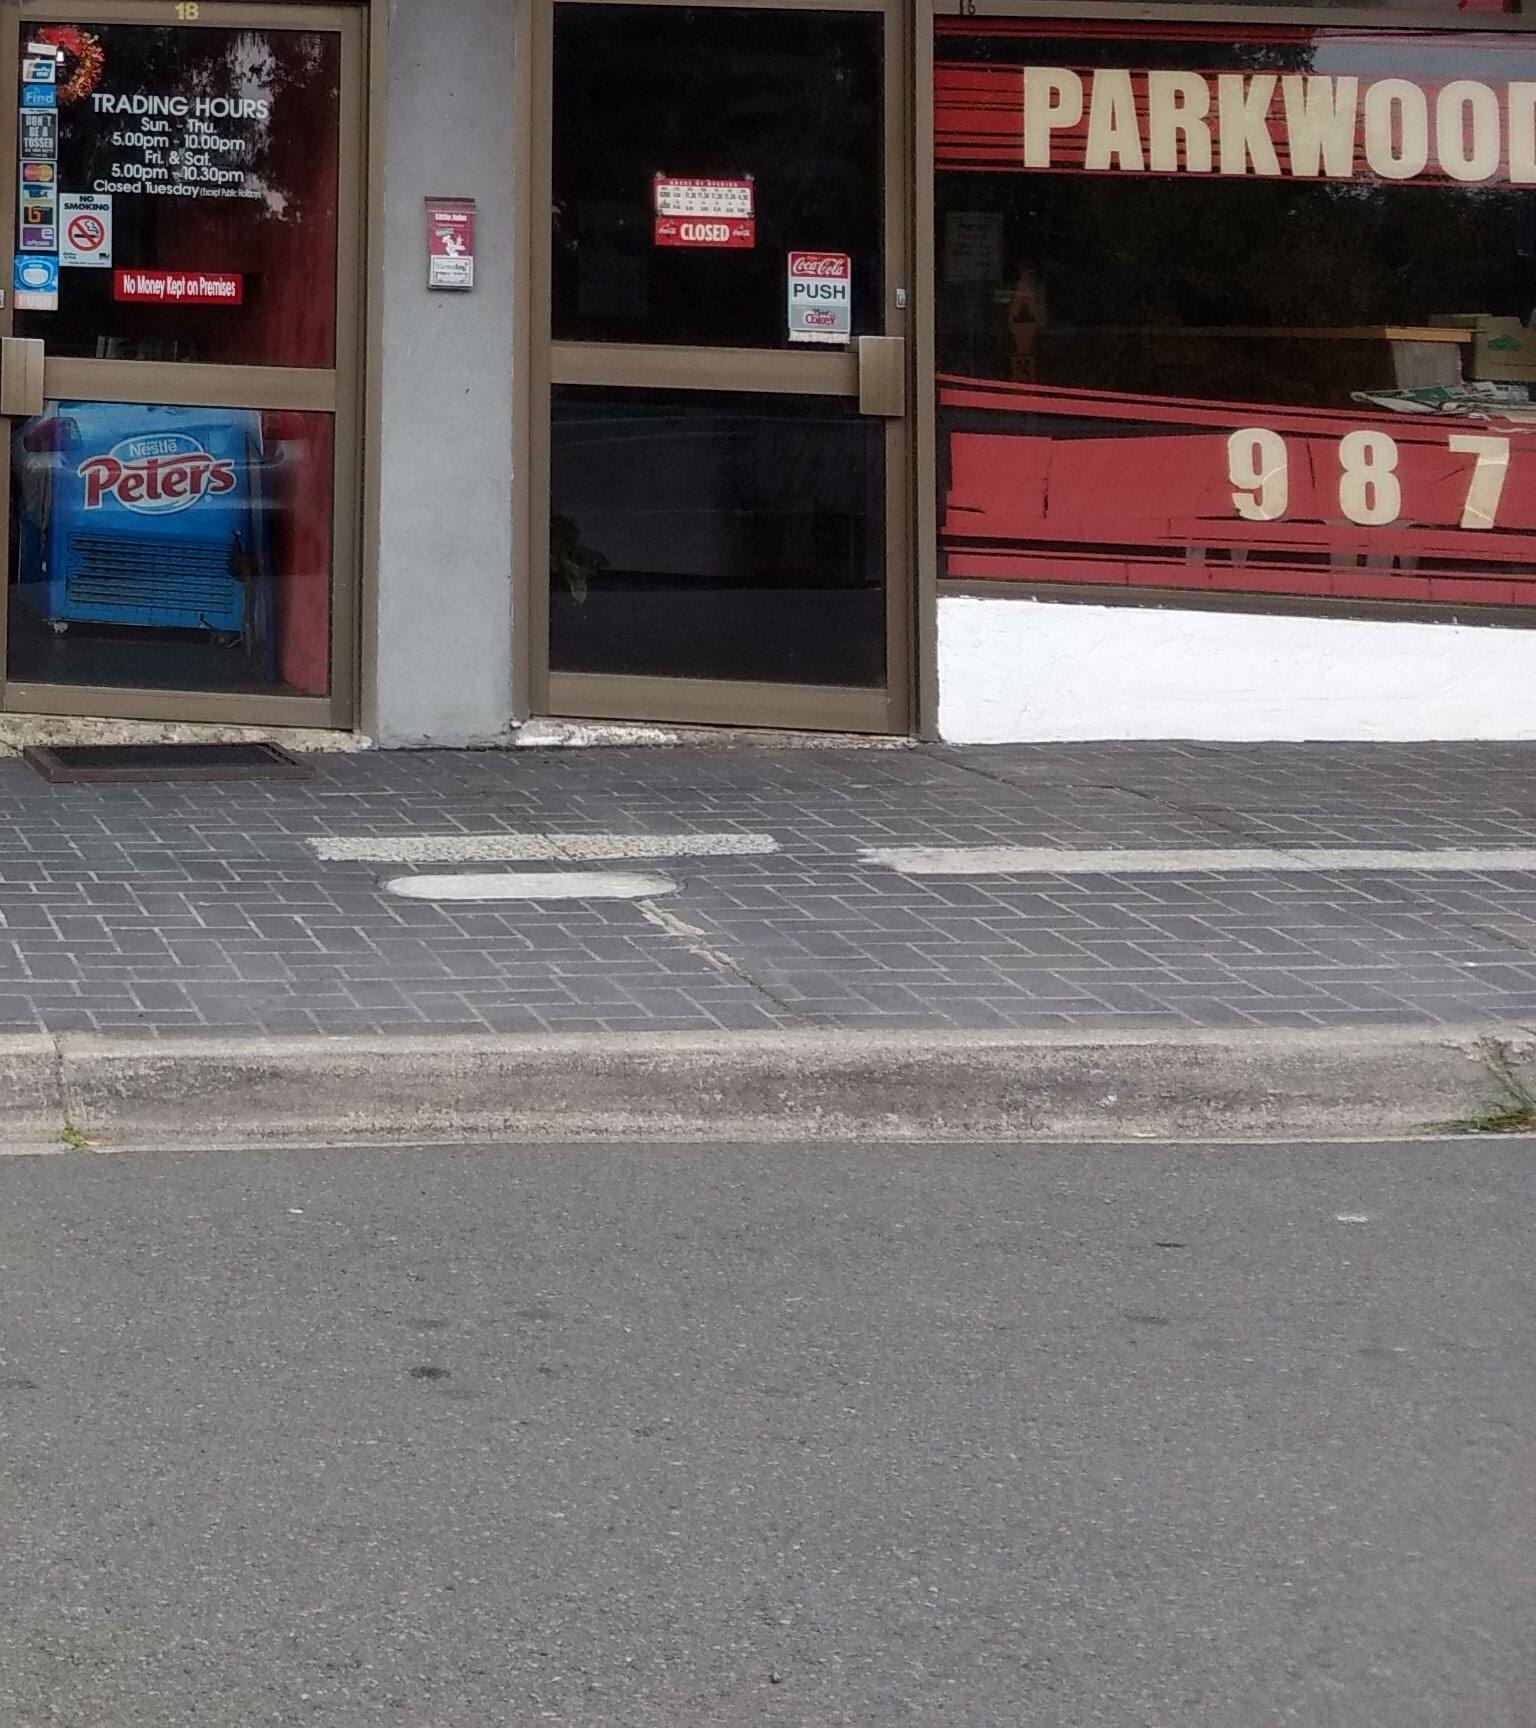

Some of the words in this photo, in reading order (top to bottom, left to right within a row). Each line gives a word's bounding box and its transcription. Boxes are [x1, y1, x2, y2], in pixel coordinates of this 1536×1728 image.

[174, 2, 199, 21] 18
[91, 92, 189, 116] TRADING
[195, 97, 269, 119] HOURS
[140, 117, 173, 132] Sun.
[187, 118, 218, 134] Thu.
[112, 132, 169, 150] 5.00pm
[184, 134, 246, 153] 10.00pm
[145, 150, 164, 165] Fri.
[169, 151, 180, 165] &
[184, 151, 212, 166] Sat.
[111, 163, 169, 181] 5.00pm
[182, 167, 245, 185] 10.30pm
[93, 180, 142, 194] Closed
[144, 181, 200, 198] Tuesday
[63, 202, 110, 211] SMOKING
[79, 195, 95, 203] NO
[680, 223, 730, 241] CLOSED
[123, 274, 136, 294] No
[136, 274, 166, 299] Money
[167, 275, 186, 299] Kept
[187, 280, 199, 296] on
[199, 276, 236, 297] Premises
[793, 283, 846, 300] PUSH
[78, 453, 237, 510] Peters
